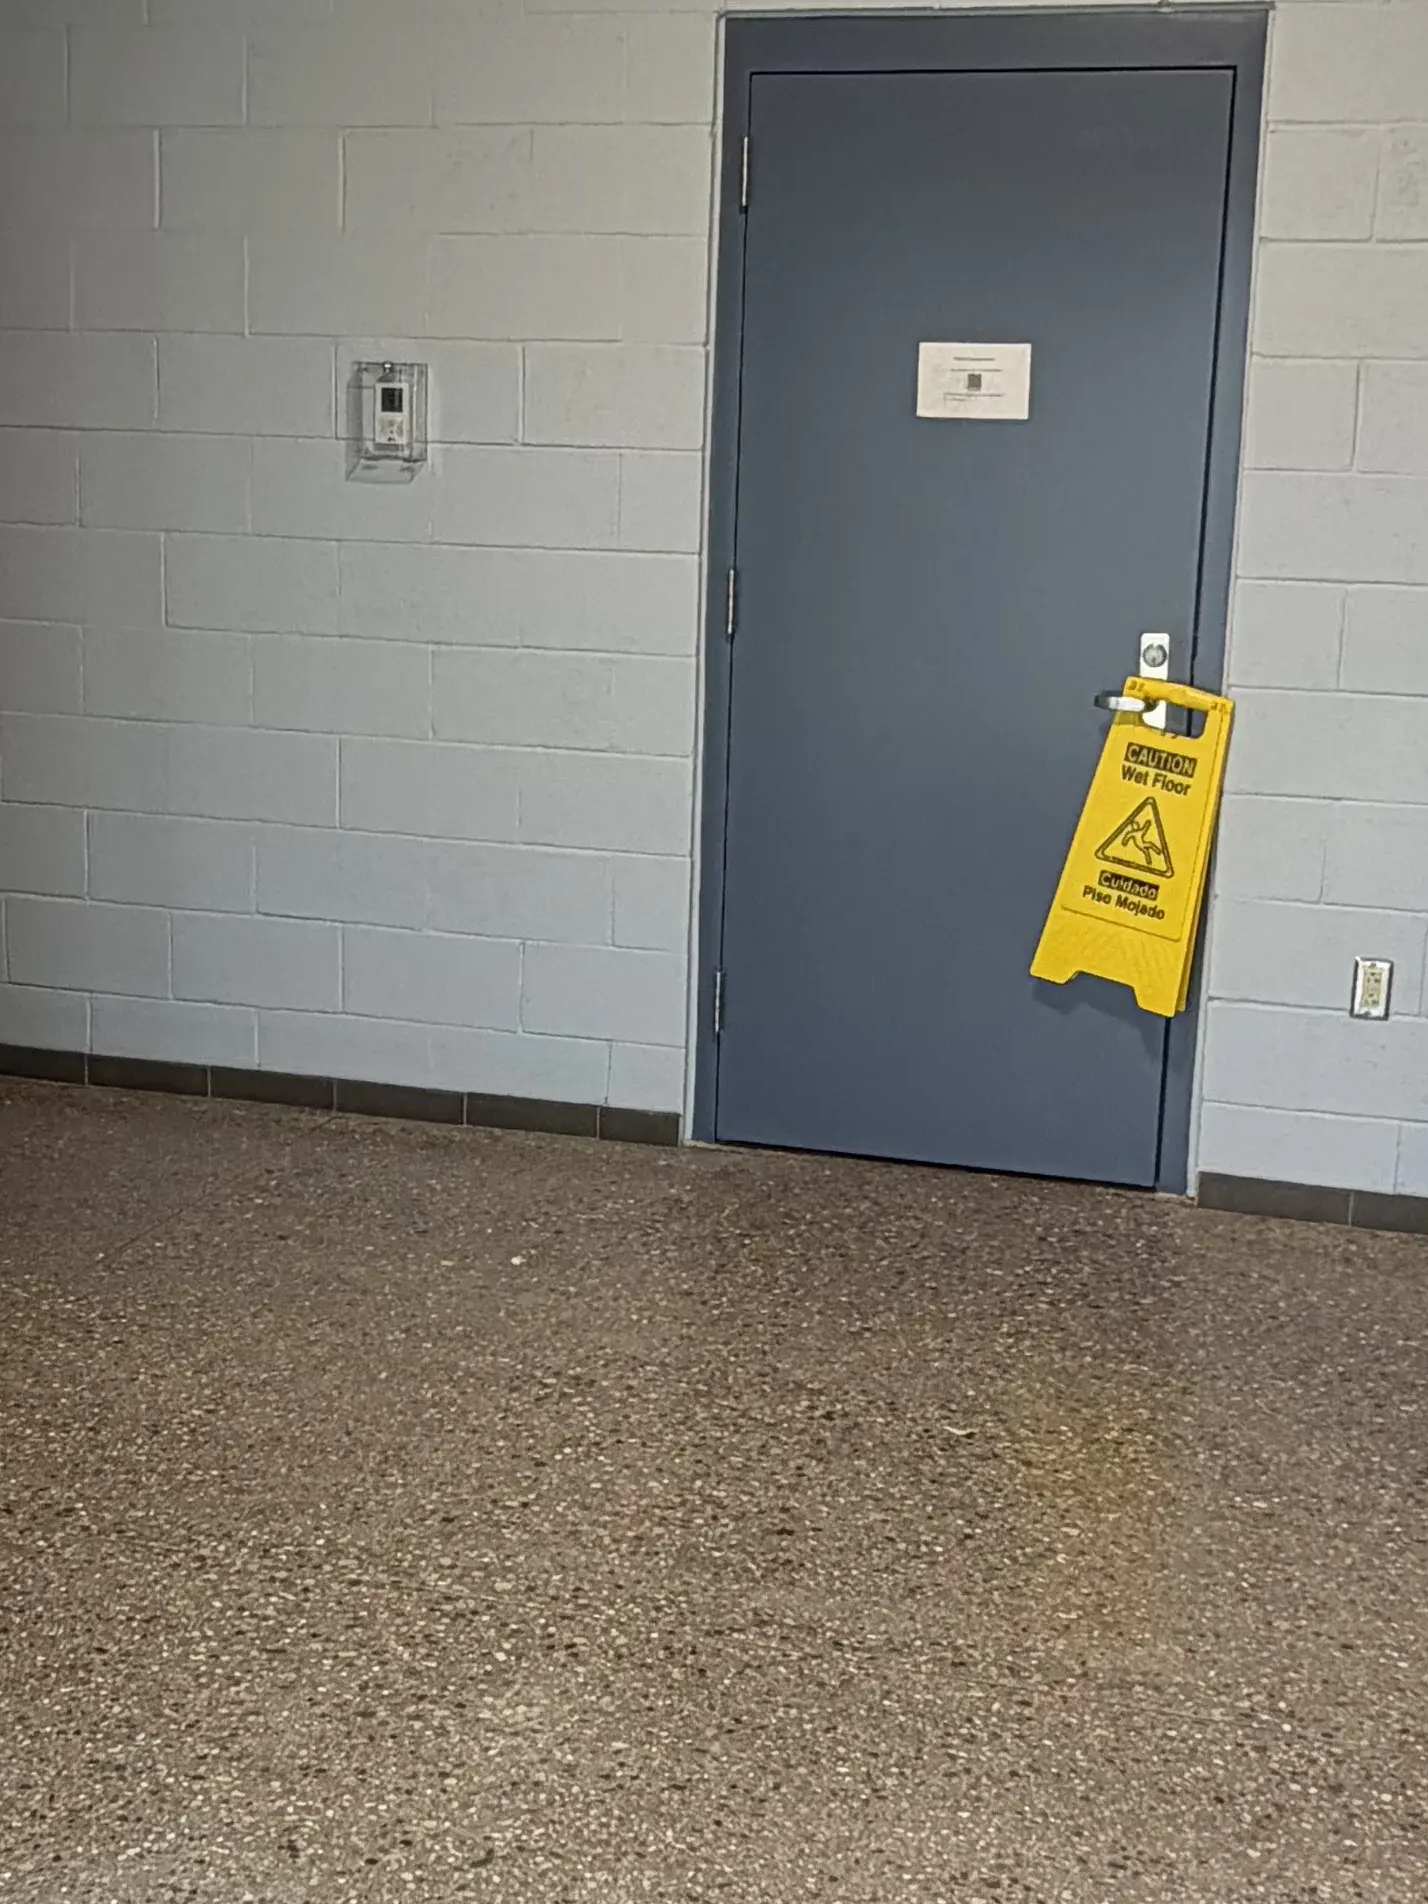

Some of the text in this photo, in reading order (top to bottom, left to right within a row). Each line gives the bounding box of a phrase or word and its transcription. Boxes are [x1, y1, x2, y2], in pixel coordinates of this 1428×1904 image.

[1127, 745, 1194, 773] CAUTION
[1122, 765, 1191, 796] Wet Floor
[1101, 873, 1156, 899] Cuidado
[1082, 885, 1166, 920] Piso Mojado
